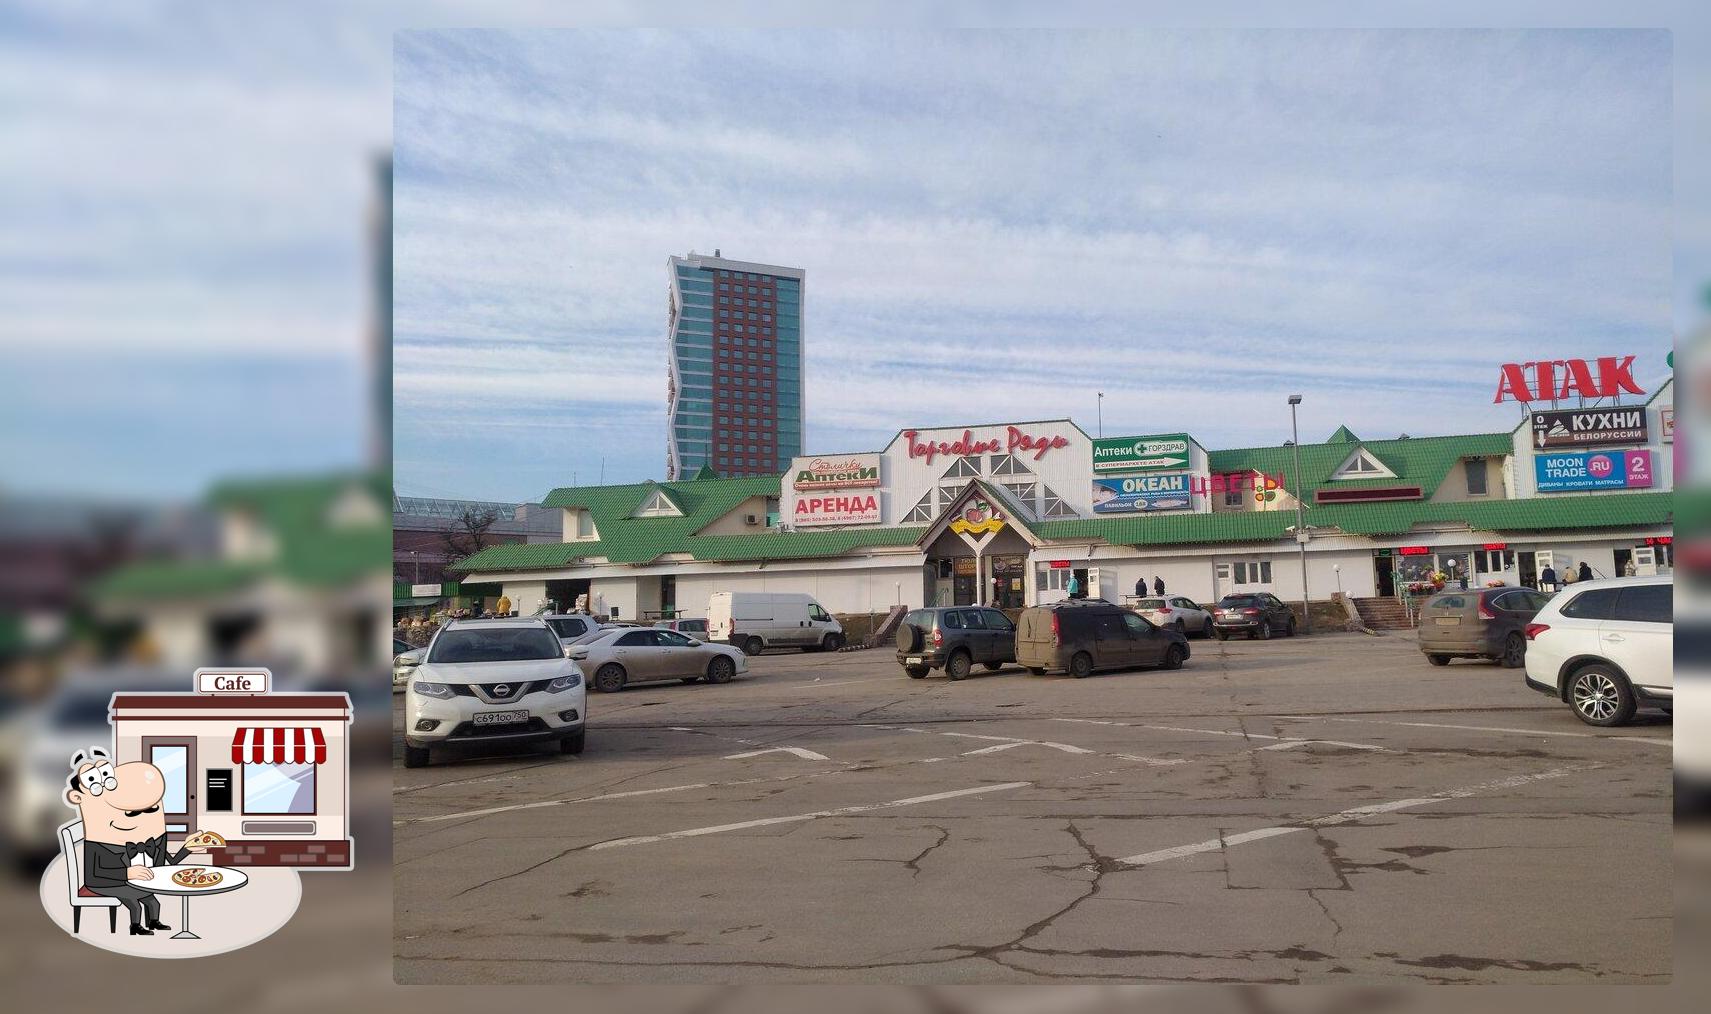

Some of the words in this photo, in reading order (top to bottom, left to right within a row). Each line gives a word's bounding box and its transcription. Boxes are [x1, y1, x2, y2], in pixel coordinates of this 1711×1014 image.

[1494, 356, 1646, 404] АТАК
[1572, 412, 1641, 431] КУХНИ
[1574, 431, 1642, 441] БЕЛОРУССИИ
[904, 430, 1000, 466] Торговые
[1007, 426, 1068, 461] Ряды
[1094, 446, 1133, 457] Аптеки
[1148, 443, 1185, 452] ГОРЗДРАВ
[1547, 458, 1583, 468] MOON
[1631, 457, 1645, 472] 2
[796, 467, 877, 482] Аптеки
[1545, 468, 1587, 478] TRADE
[1123, 477, 1183, 492] ОКЕАН
[795, 496, 878, 514] АРЕНДА
